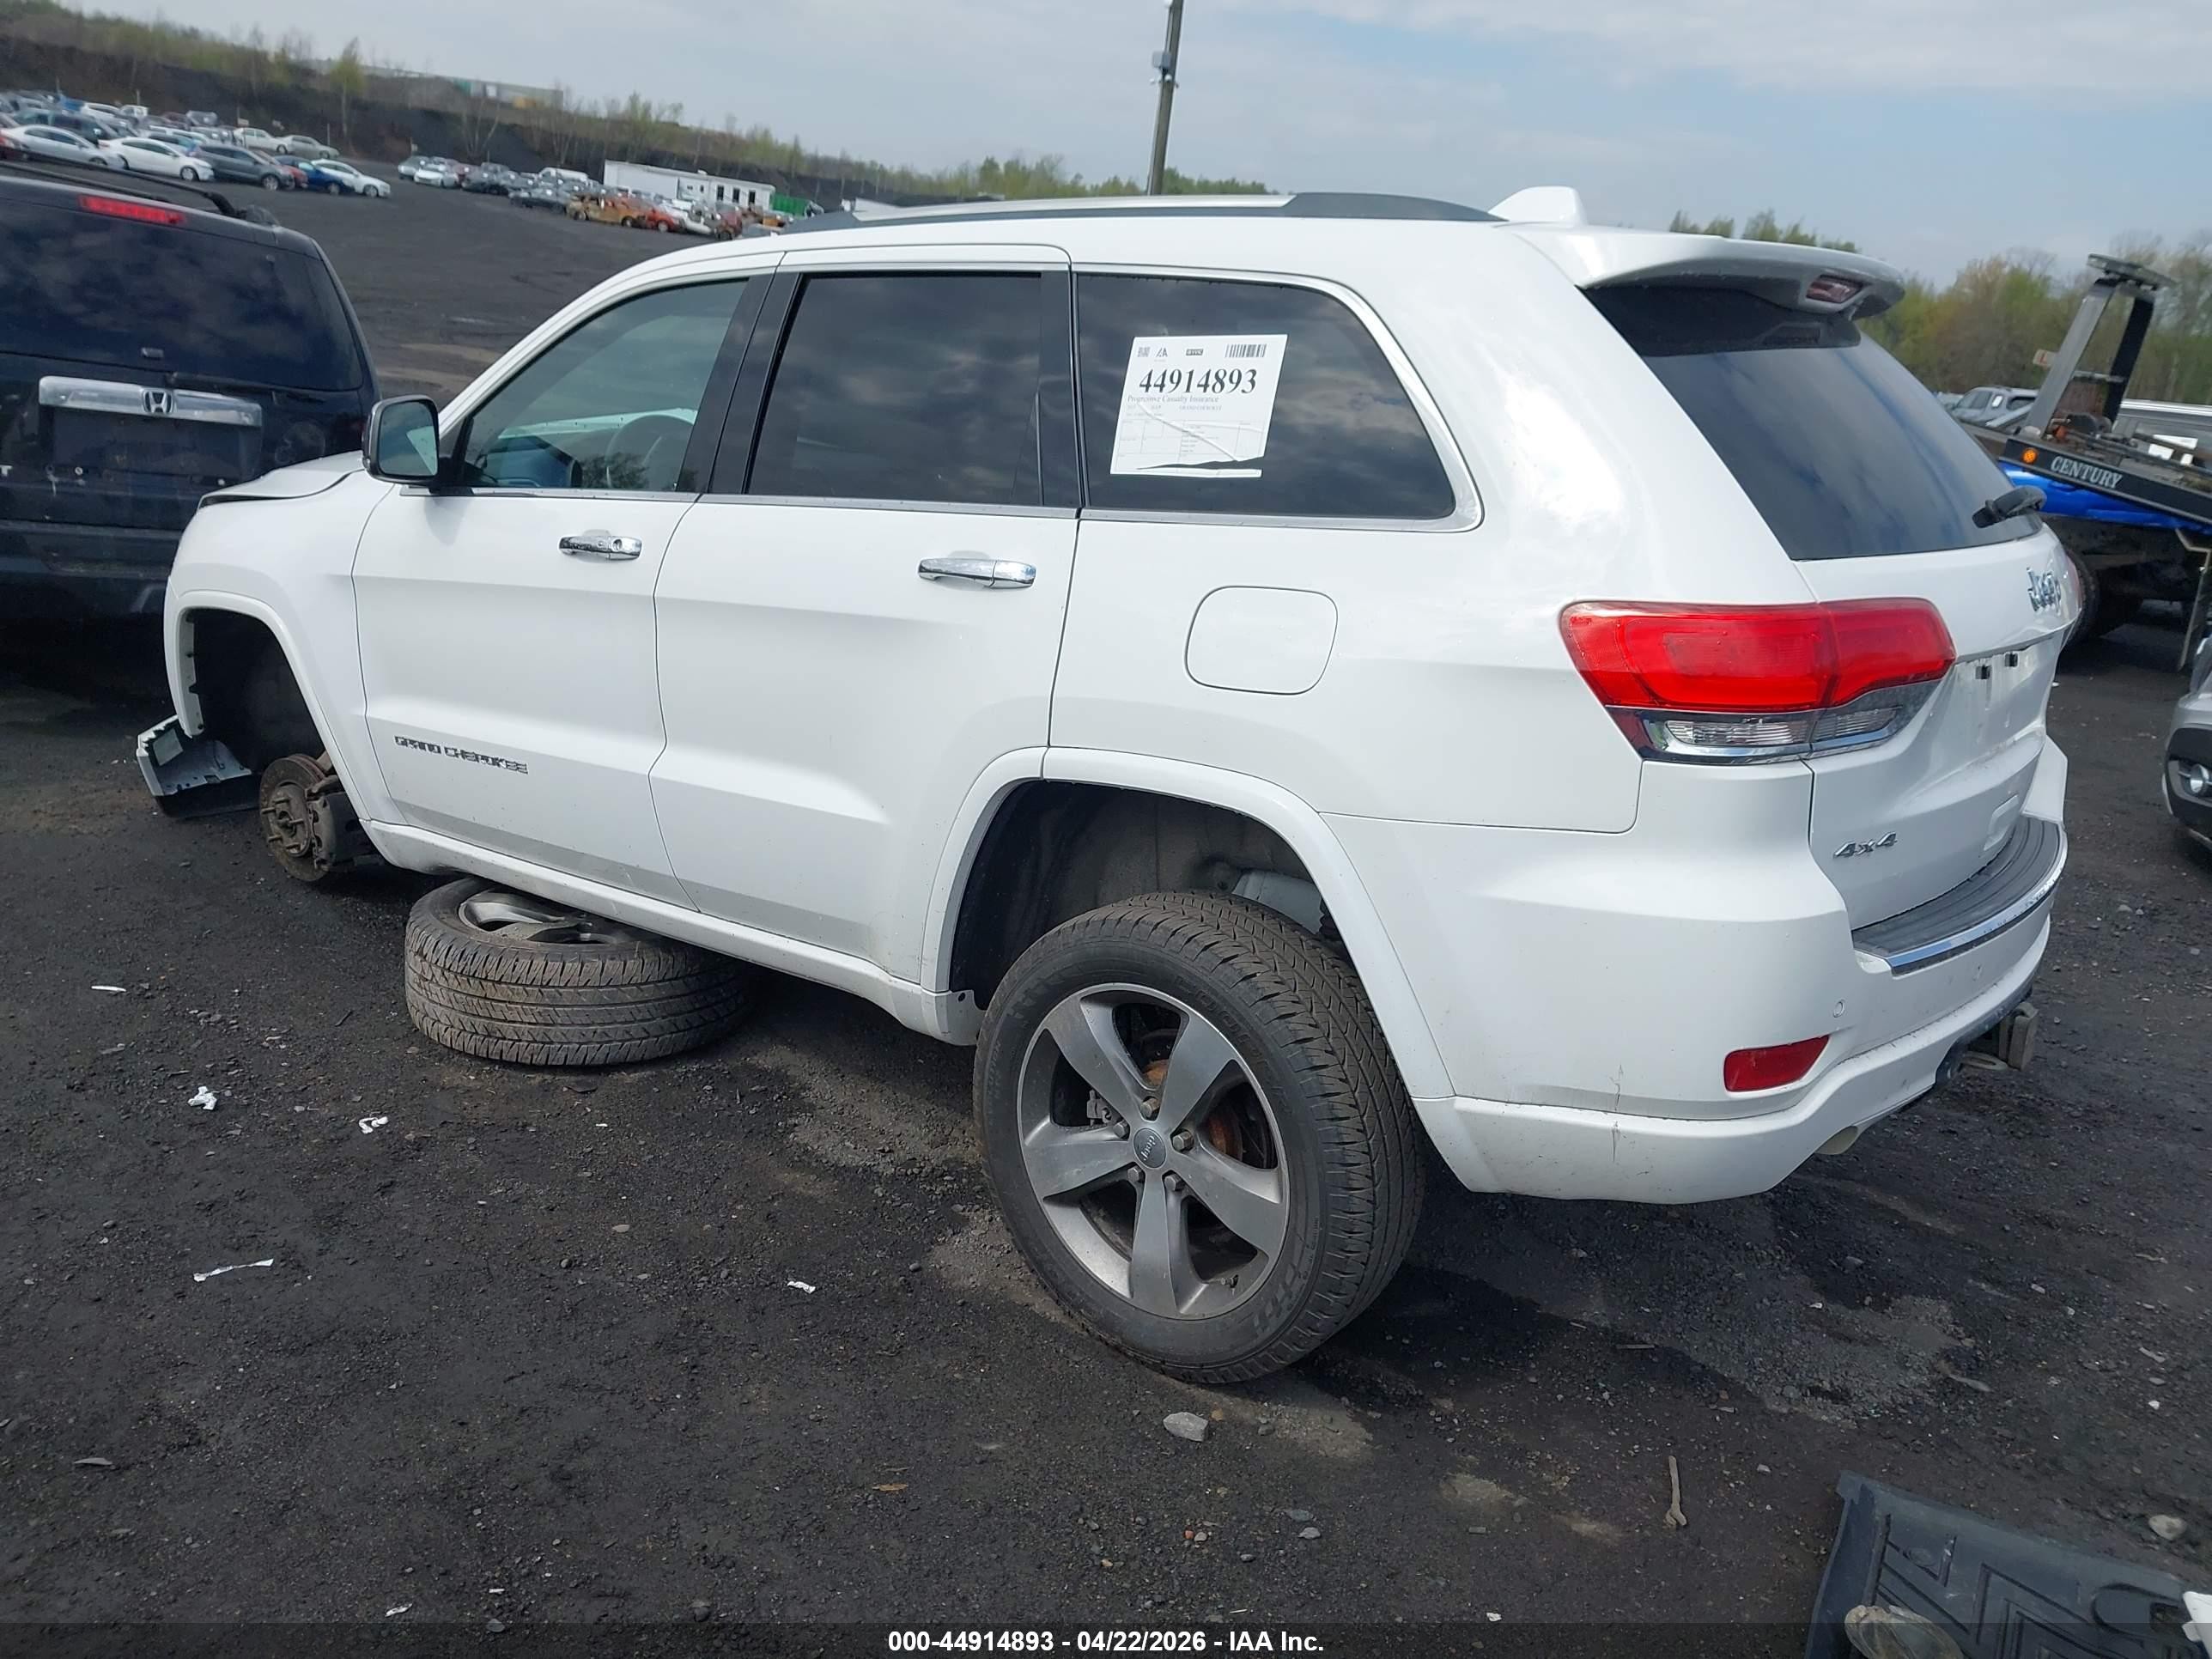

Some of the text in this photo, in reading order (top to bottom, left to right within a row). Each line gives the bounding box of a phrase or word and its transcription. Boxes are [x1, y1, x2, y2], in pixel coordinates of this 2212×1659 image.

[1139, 368, 1258, 394] 44914893
[2051, 456, 2123, 489] CENTURY
[394, 735, 529, 775] GRAND CHEROKEE
